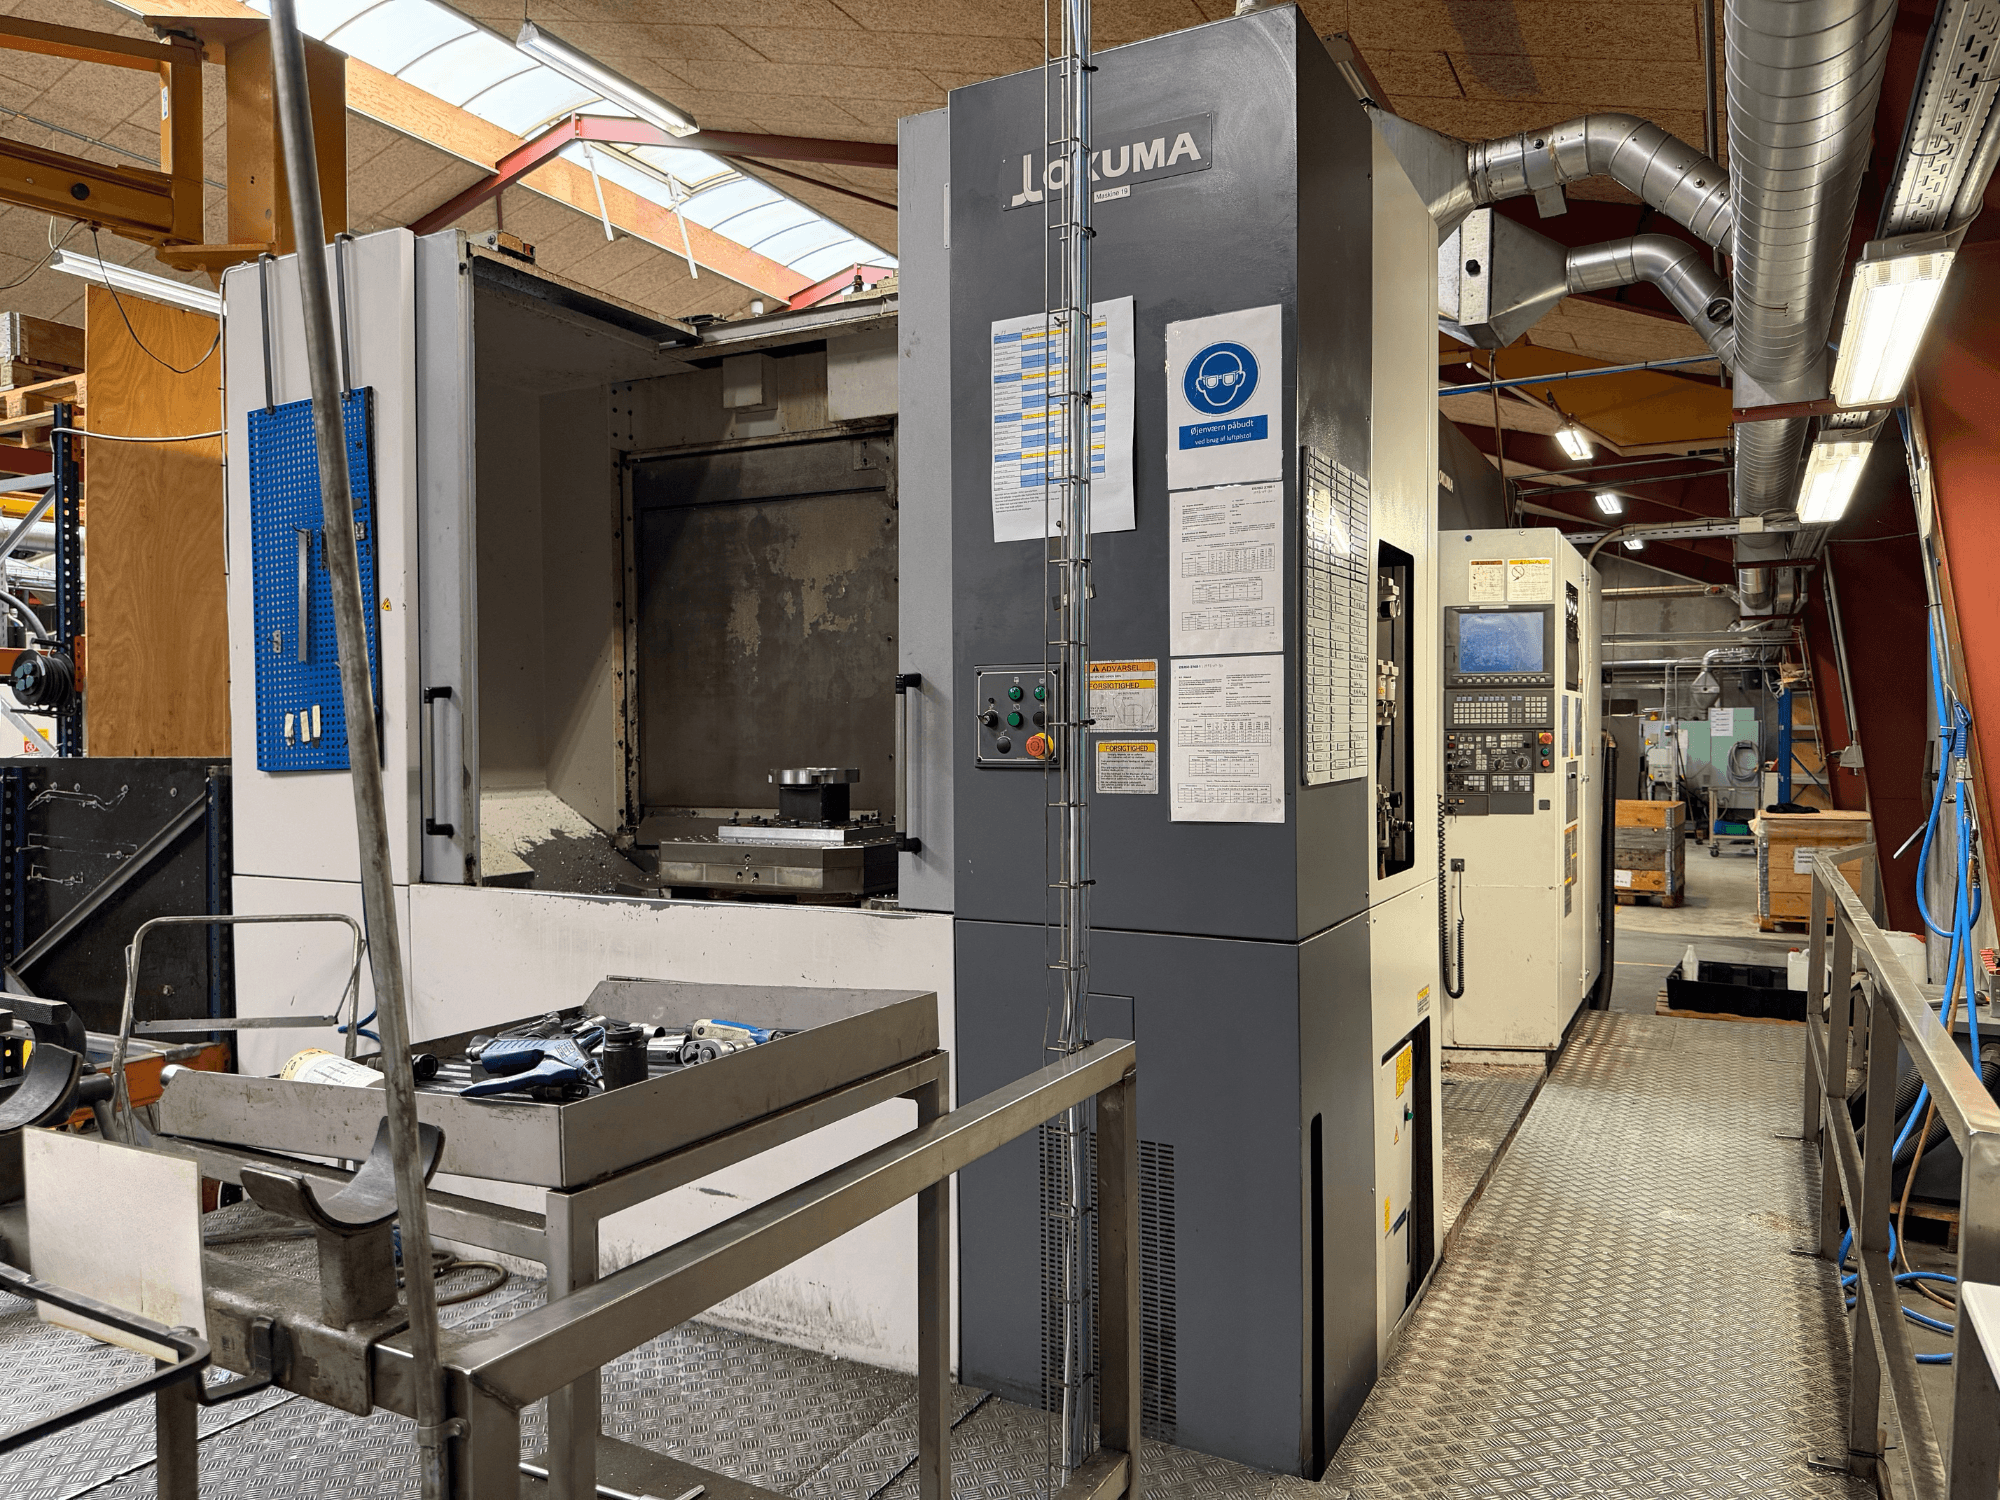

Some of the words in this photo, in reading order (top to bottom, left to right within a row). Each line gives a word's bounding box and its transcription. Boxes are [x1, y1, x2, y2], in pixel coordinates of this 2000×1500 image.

[1096, 190, 1120, 200] Maskine
[1190, 425, 1225, 435] Øjenværn
[1228, 420, 1254, 431] påbudt
[1227, 432, 1252, 441] luftpistol
[1101, 664, 1141, 672] ADVARSEL
